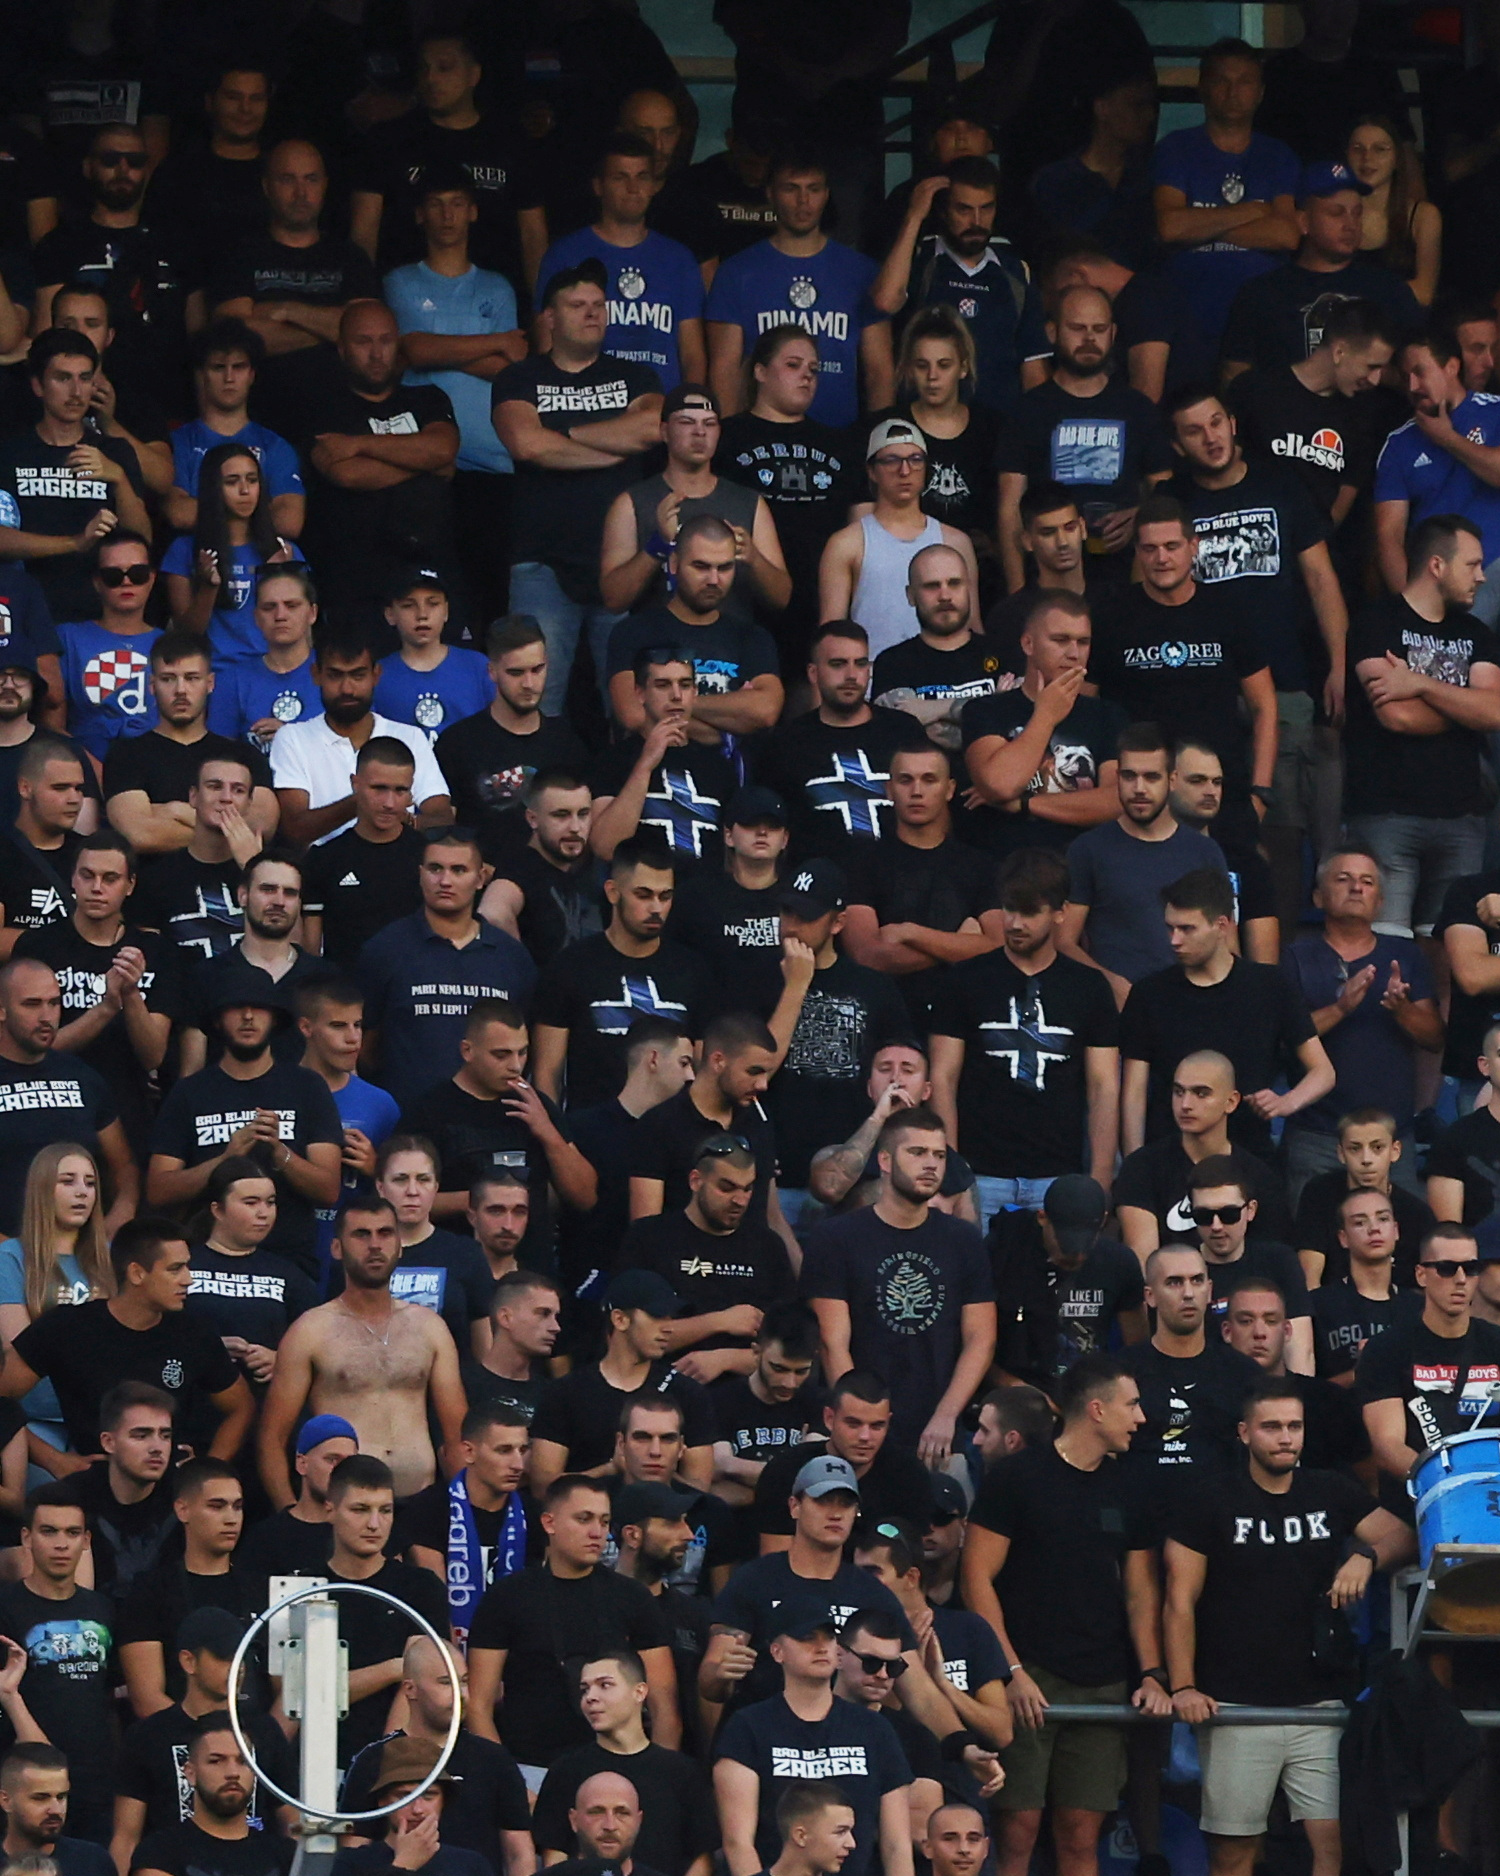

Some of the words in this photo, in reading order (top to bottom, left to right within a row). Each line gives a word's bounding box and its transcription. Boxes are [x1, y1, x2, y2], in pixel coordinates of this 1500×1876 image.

[537, 391, 629, 412] ZAGREB
[1271, 432, 1344, 473] ellesse
[19, 480, 108, 500] ZAGREB
[1195, 524, 1209, 534] AD
[1212, 518, 1240, 529] BLUE
[1242, 512, 1271, 525] BOYS
[744, 918, 771, 929] THE
[723, 924, 773, 937] NORTH
[738, 935, 775, 947] FACE
[18, 1080, 47, 1093] BLUE
[49, 1080, 81, 1092] BOYS
[195, 1111, 224, 1126] BAD
[715, 1264, 754, 1272] ALPHA
[215, 1273, 249, 1284] BLUE
[252, 1275, 286, 1287] BOYS
[187, 1280, 285, 1303] ZAGREB
[1069, 1289, 1090, 1302] LIKE
[1092, 1289, 1104, 1303] IT
[1415, 1368, 1438, 1380] BAD
[1468, 1368, 1499, 1380] BOYS
[1164, 1441, 1186, 1452] nike
[772, 1746, 800, 1759] BAD
[829, 1746, 866, 1759] BOYS
